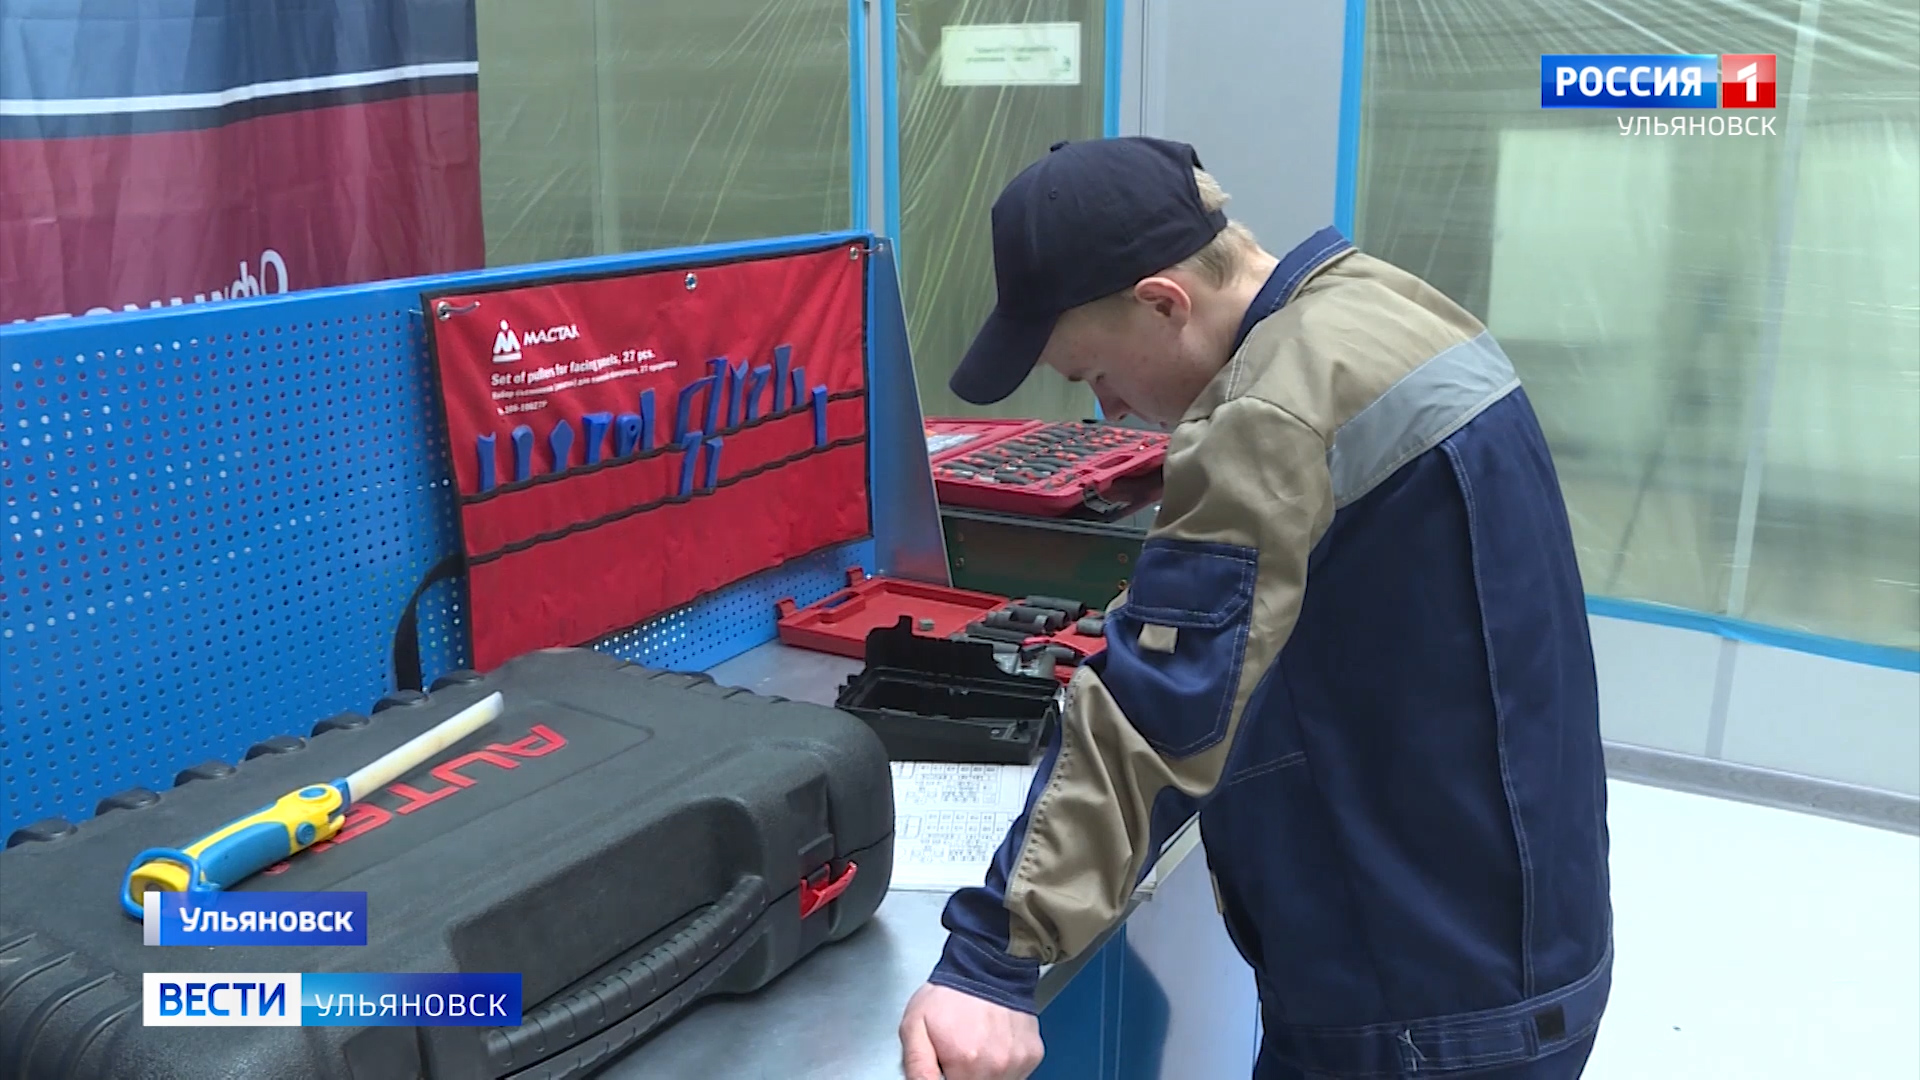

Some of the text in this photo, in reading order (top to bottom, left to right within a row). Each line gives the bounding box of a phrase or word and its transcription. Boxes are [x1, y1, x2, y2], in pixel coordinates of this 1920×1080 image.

[491, 372, 512, 386] Set
[513, 370, 526, 384] of
[622, 349, 636, 363] 27
